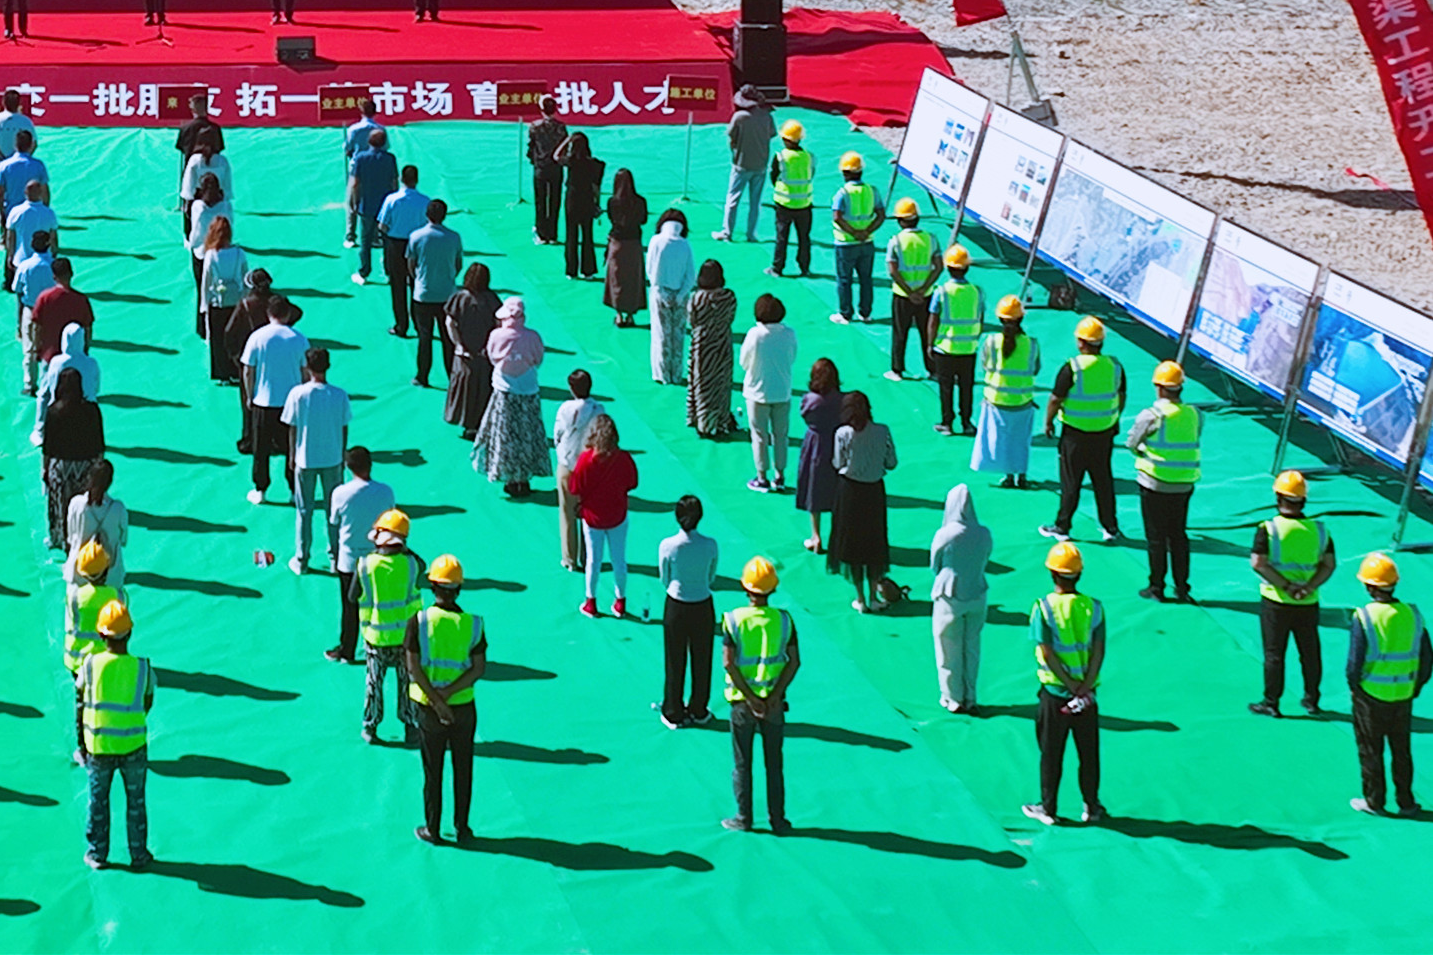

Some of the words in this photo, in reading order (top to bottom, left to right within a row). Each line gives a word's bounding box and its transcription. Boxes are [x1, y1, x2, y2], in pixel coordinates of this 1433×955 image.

[235, 81, 453, 117] 拓一市场
[465, 80, 676, 116] 育批人才
